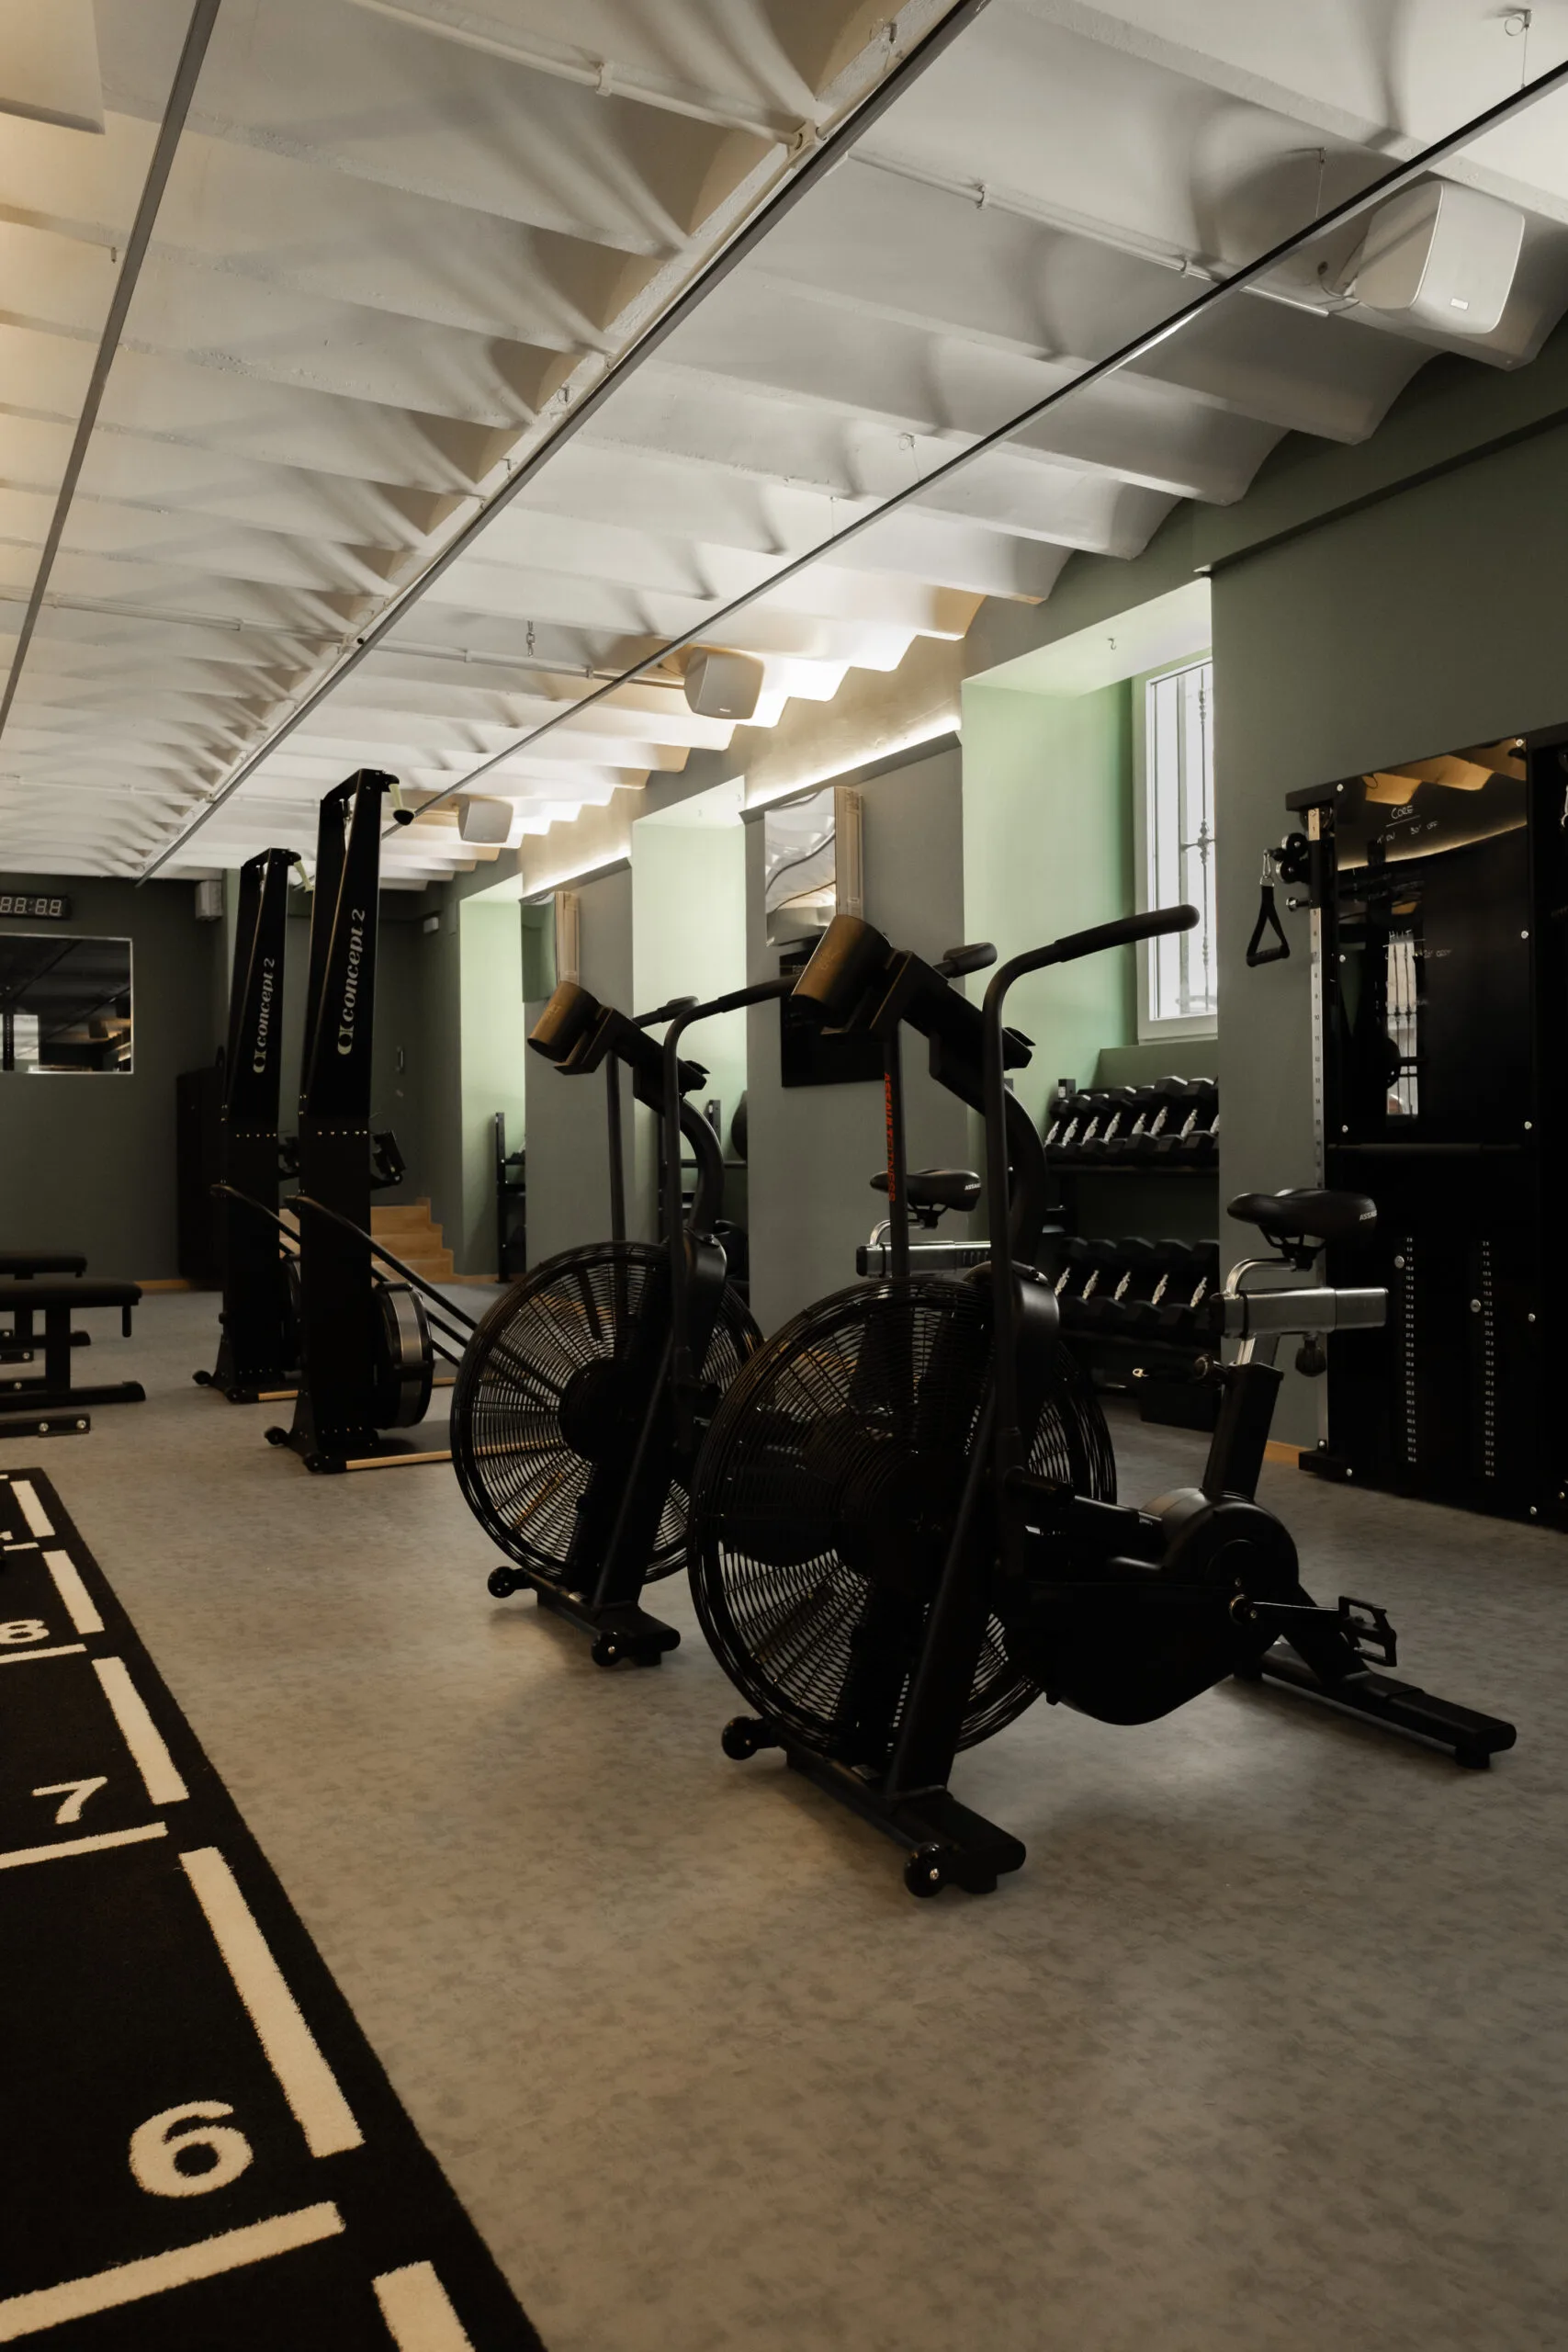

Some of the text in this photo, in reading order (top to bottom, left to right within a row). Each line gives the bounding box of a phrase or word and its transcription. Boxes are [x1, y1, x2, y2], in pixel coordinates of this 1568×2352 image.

[1391, 805, 1415, 820] CORE
[342, 908, 366, 1023] concept 2
[256, 956, 276, 1047] concept 2
[0, 1618, 51, 1645] 8
[32, 1775, 108, 1825] 7
[128, 2099, 254, 2198] 6
